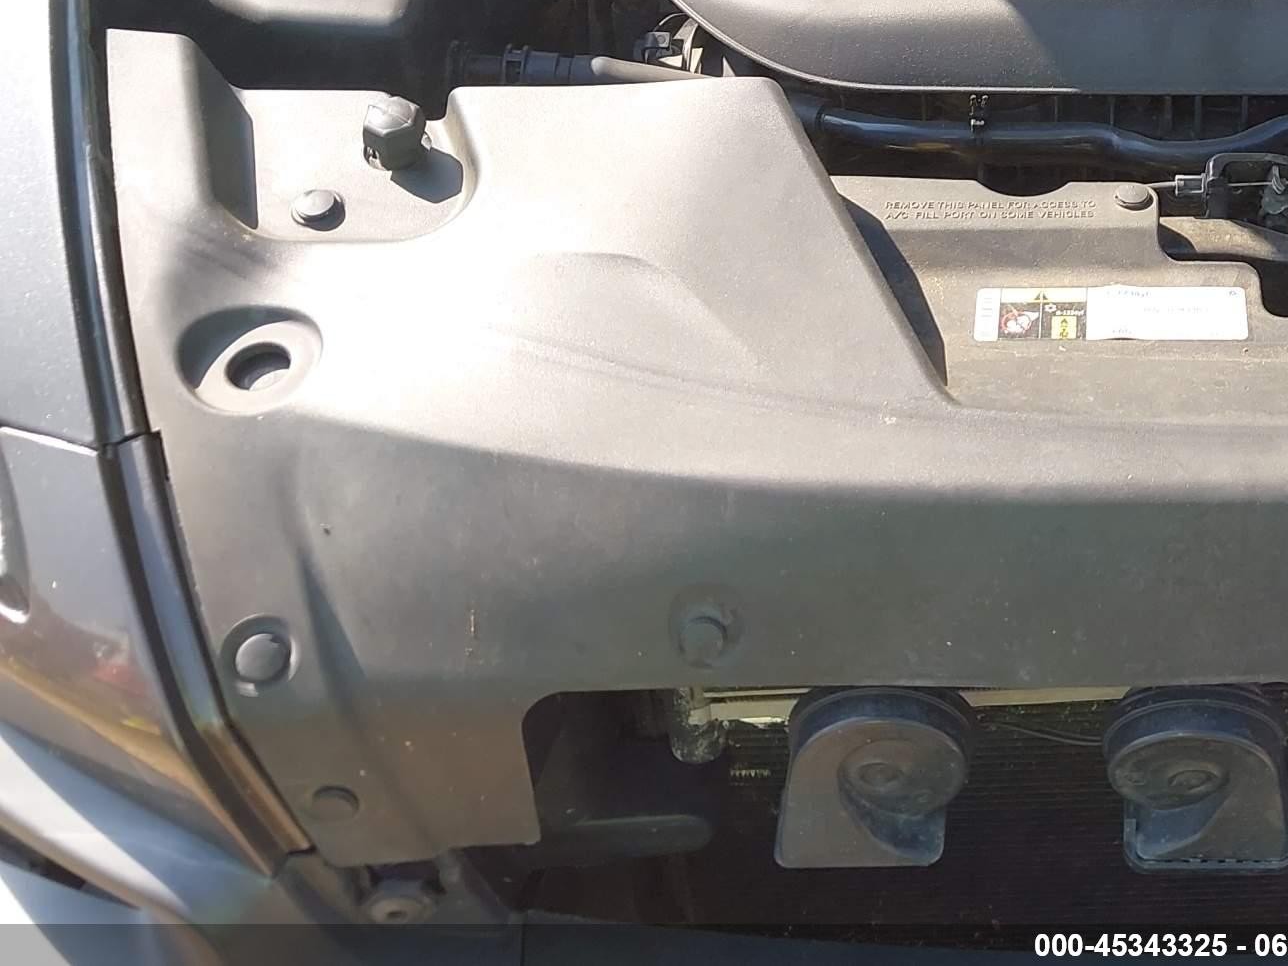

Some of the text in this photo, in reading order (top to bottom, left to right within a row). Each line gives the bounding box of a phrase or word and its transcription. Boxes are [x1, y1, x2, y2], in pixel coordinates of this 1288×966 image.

[884, 200, 1097, 210] REMOVE THIS PANEL FOR ACCESS TO
[884, 210, 1095, 220] A/C FILL PORT ON SOME VEHICLES
